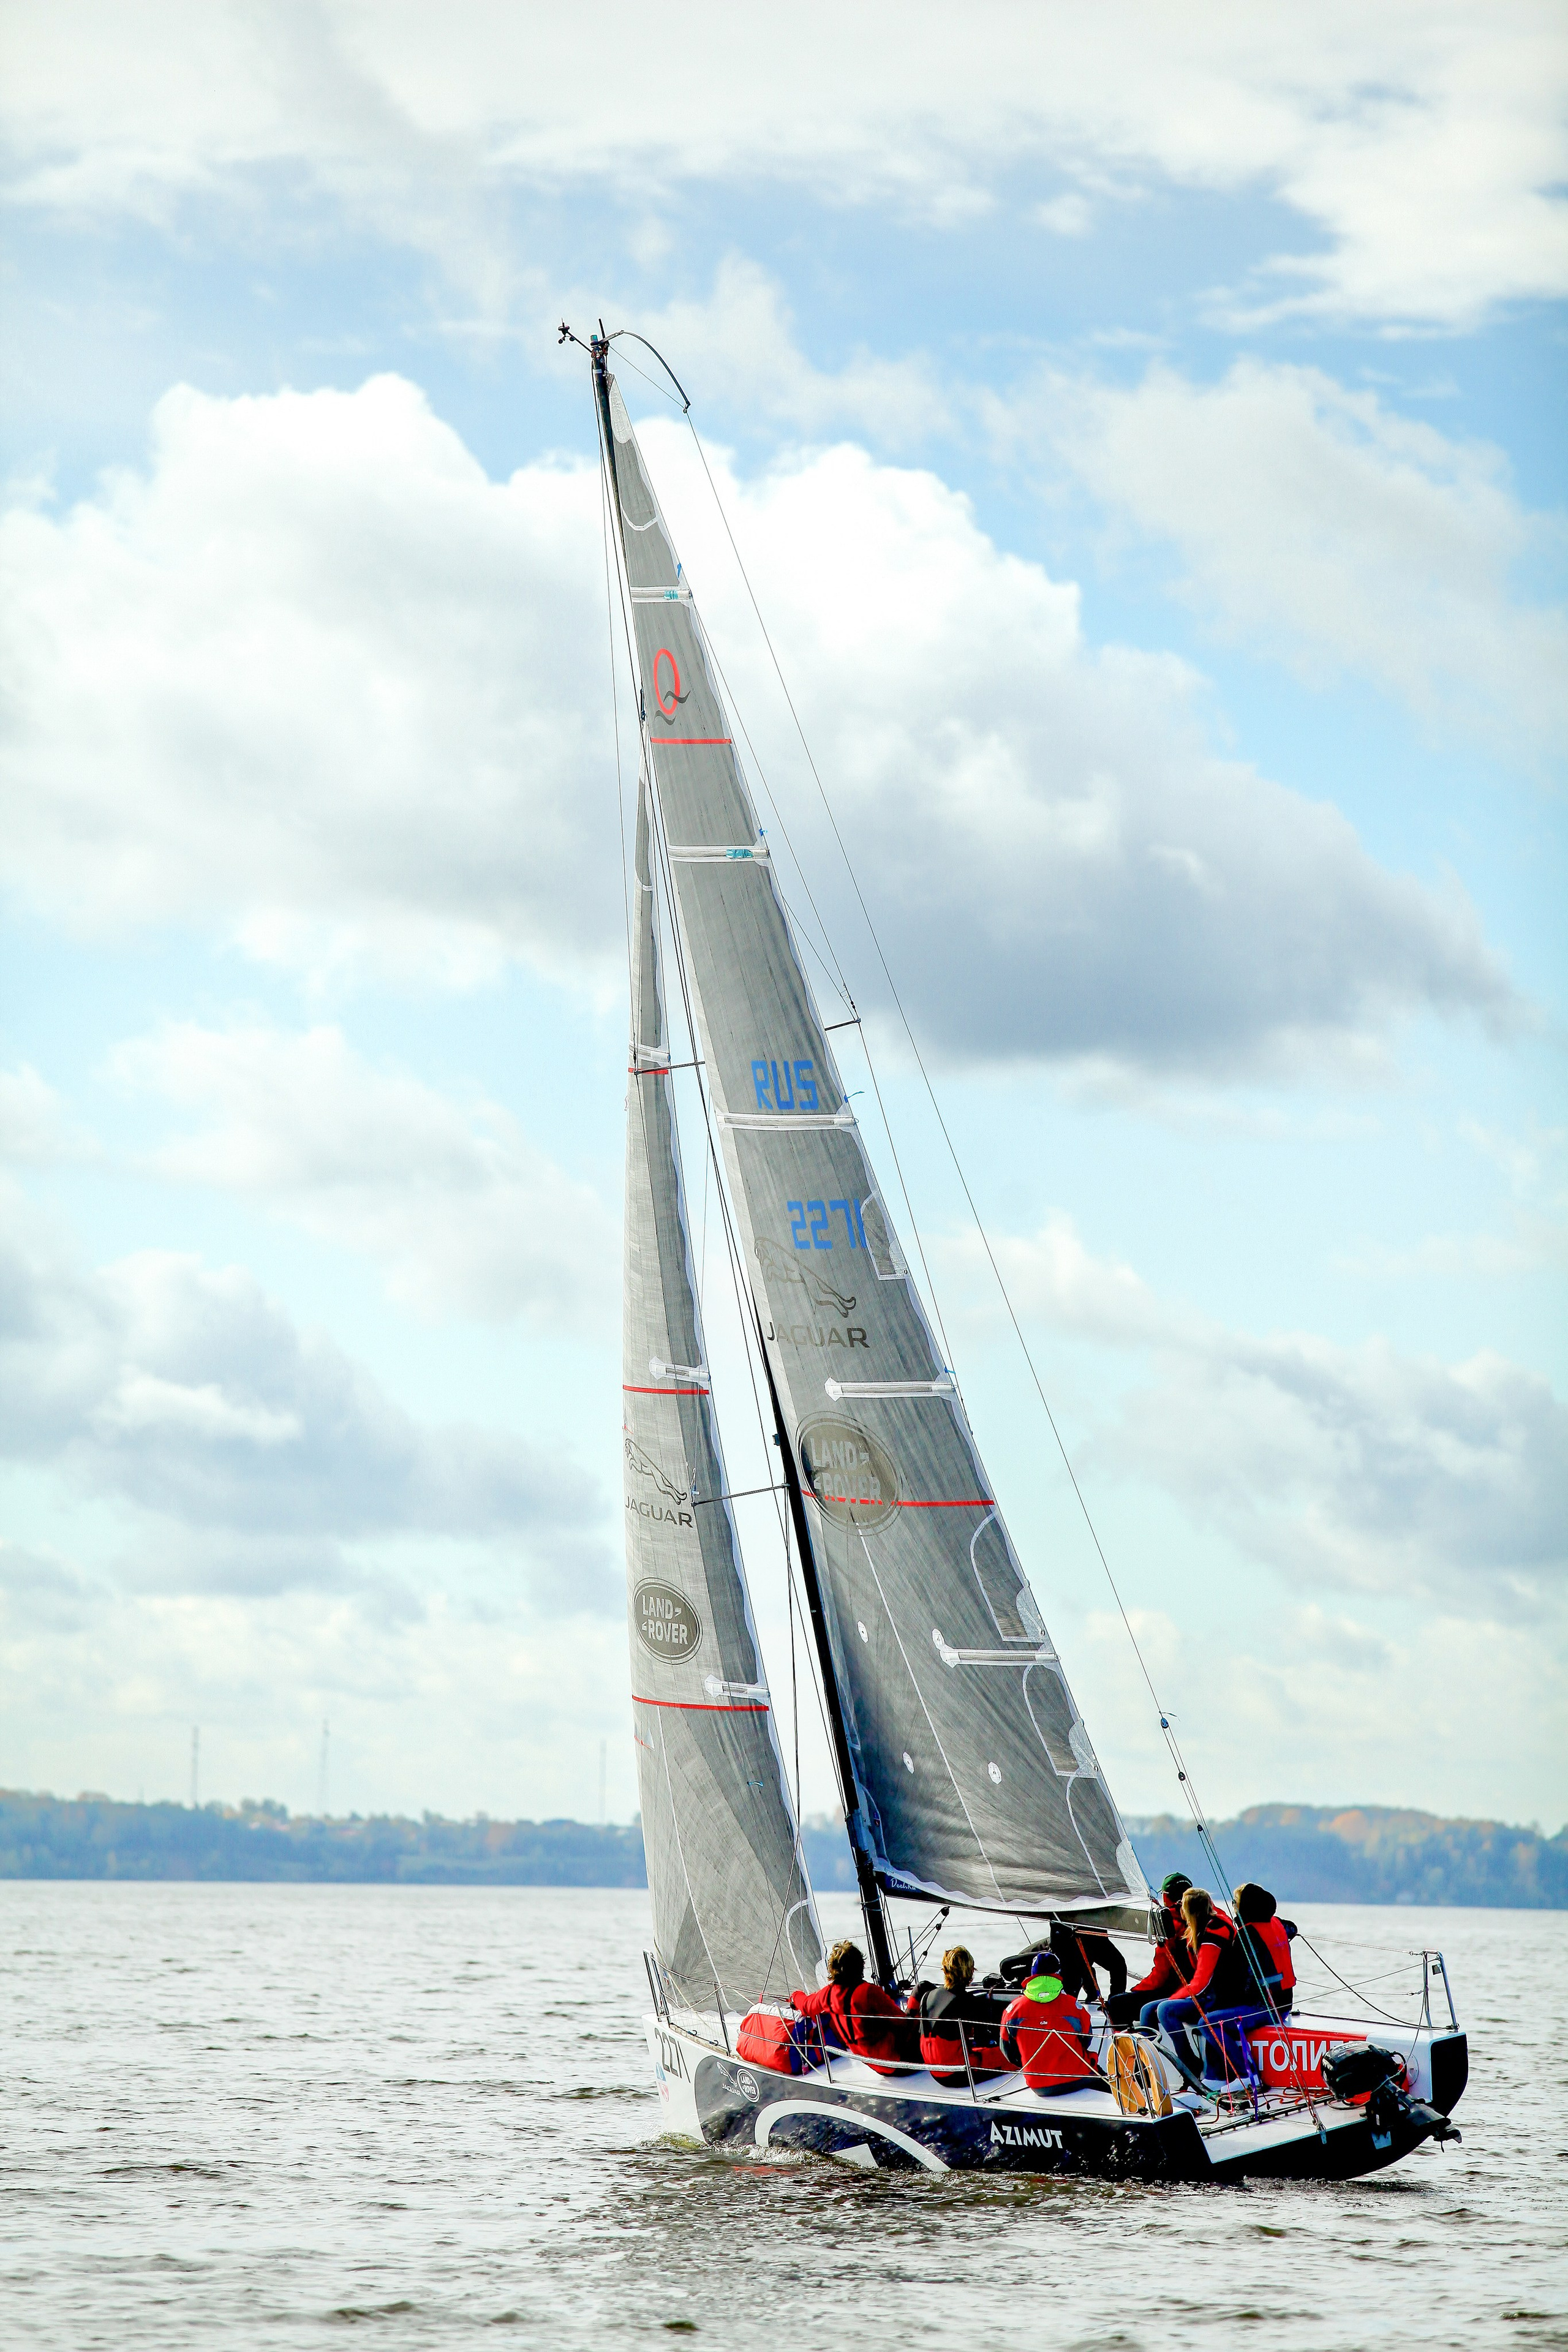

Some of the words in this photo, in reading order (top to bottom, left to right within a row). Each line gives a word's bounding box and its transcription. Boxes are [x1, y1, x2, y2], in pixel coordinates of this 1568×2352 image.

[750, 1060, 820, 1110] RUS
[786, 1198, 867, 1250] 2271
[767, 1321, 871, 1348] JAGUAR
[810, 1438, 858, 1468] LAND
[822, 1472, 884, 1506] ROVER
[625, 1496, 693, 1528] JAGUAR
[642, 1594, 674, 1619] LAND
[647, 1619, 688, 1645] ROVER
[722, 2083, 742, 2097] JAGUAR
[990, 2120, 1063, 2149] AZIMUT
